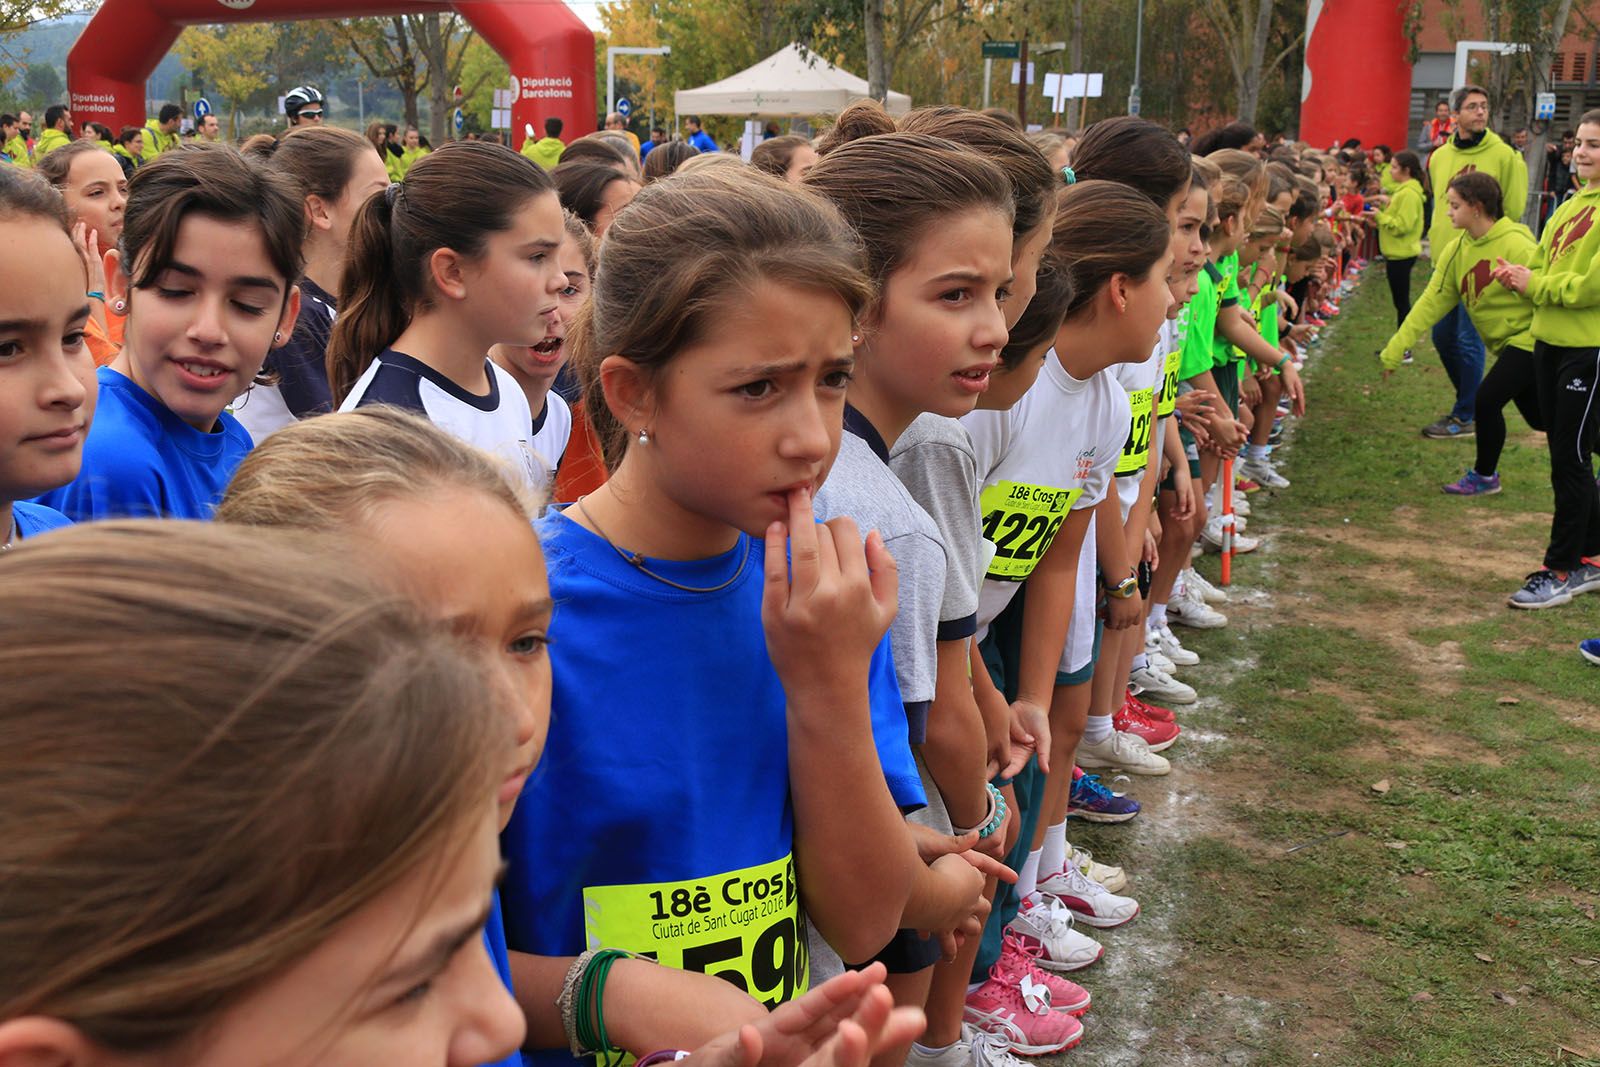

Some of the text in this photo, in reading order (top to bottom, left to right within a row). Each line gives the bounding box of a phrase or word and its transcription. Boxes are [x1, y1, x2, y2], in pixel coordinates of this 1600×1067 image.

[522, 76, 572, 88] Diputació
[72, 93, 115, 103] Diputació
[522, 88, 573, 99] Barcelona
[72, 103, 115, 113] Barcelona
[1009, 485, 1054, 503] 18è Cros
[649, 872, 784, 921] 18è Cros
[652, 894, 784, 940] Ciutat de Sant Cugat 2016
